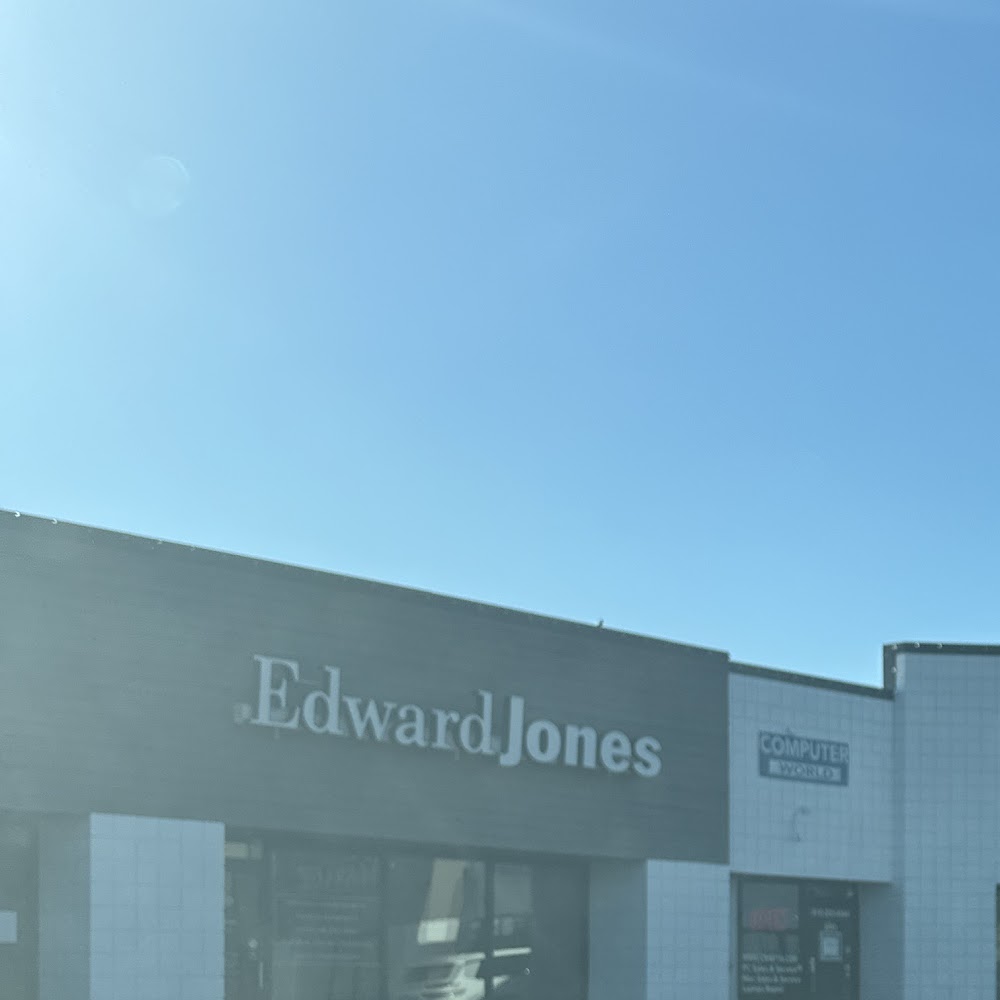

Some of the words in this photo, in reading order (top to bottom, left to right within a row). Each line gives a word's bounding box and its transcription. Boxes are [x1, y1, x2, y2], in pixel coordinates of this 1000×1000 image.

[251, 653, 495, 757] Edward
[498, 694, 663, 779] Jones
[761, 735, 848, 763] COMPUTER
[780, 761, 834, 780] WORLD
